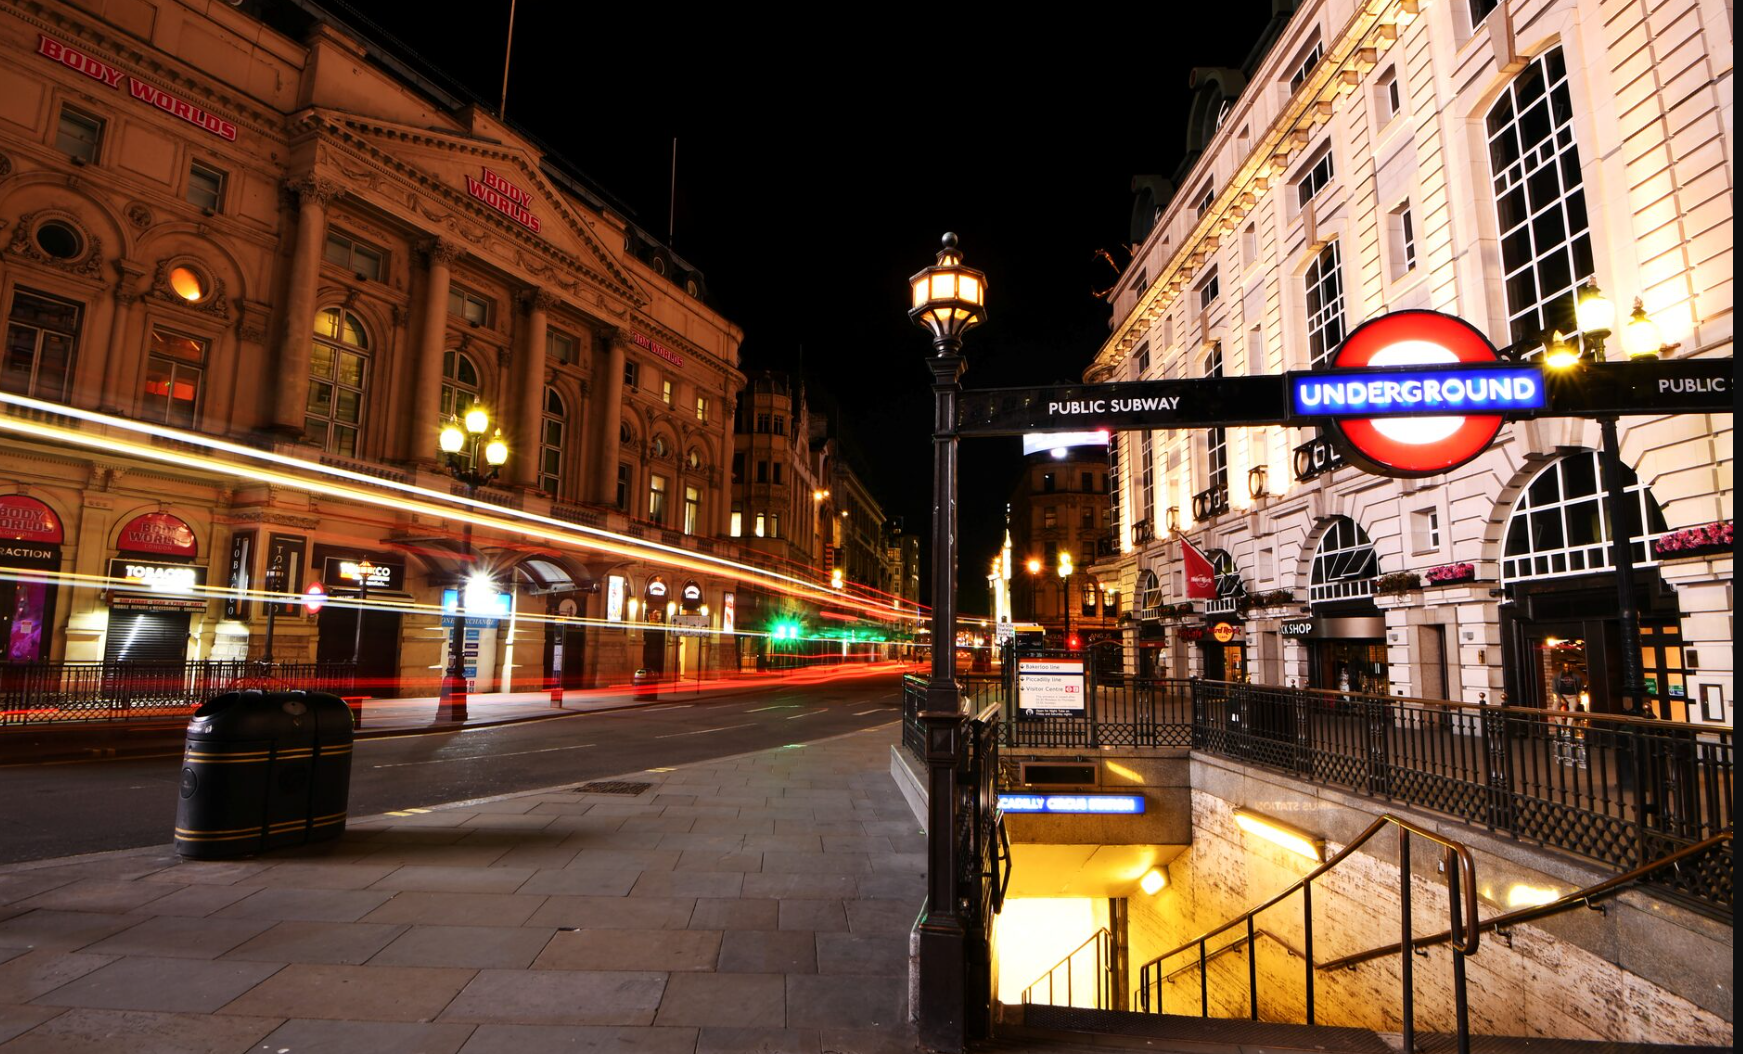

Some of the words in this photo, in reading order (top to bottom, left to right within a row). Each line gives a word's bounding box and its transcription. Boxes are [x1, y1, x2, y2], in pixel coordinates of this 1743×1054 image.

[38, 35, 125, 90] BODY
[129, 77, 237, 142] WORLDS
[483, 167, 533, 209] BODY
[466, 175, 541, 234] WORLDS
[630, 330, 650, 349] ODY
[651, 339, 684, 367] WORLDS
[1300, 377, 1536, 406] UNDERGROUND
[1658, 377, 1726, 393] PUBLIC
[1048, 400, 1105, 415] PUBLIC
[1110, 396, 1180, 412] SUBWAY
[0, 518, 54, 533] ORLDS
[129, 531, 188, 546] WORL
[228, 537, 241, 615] TOBACCO
[1289, 623, 1312, 634] SHOP
[999, 797, 1044, 810] CADILLY
